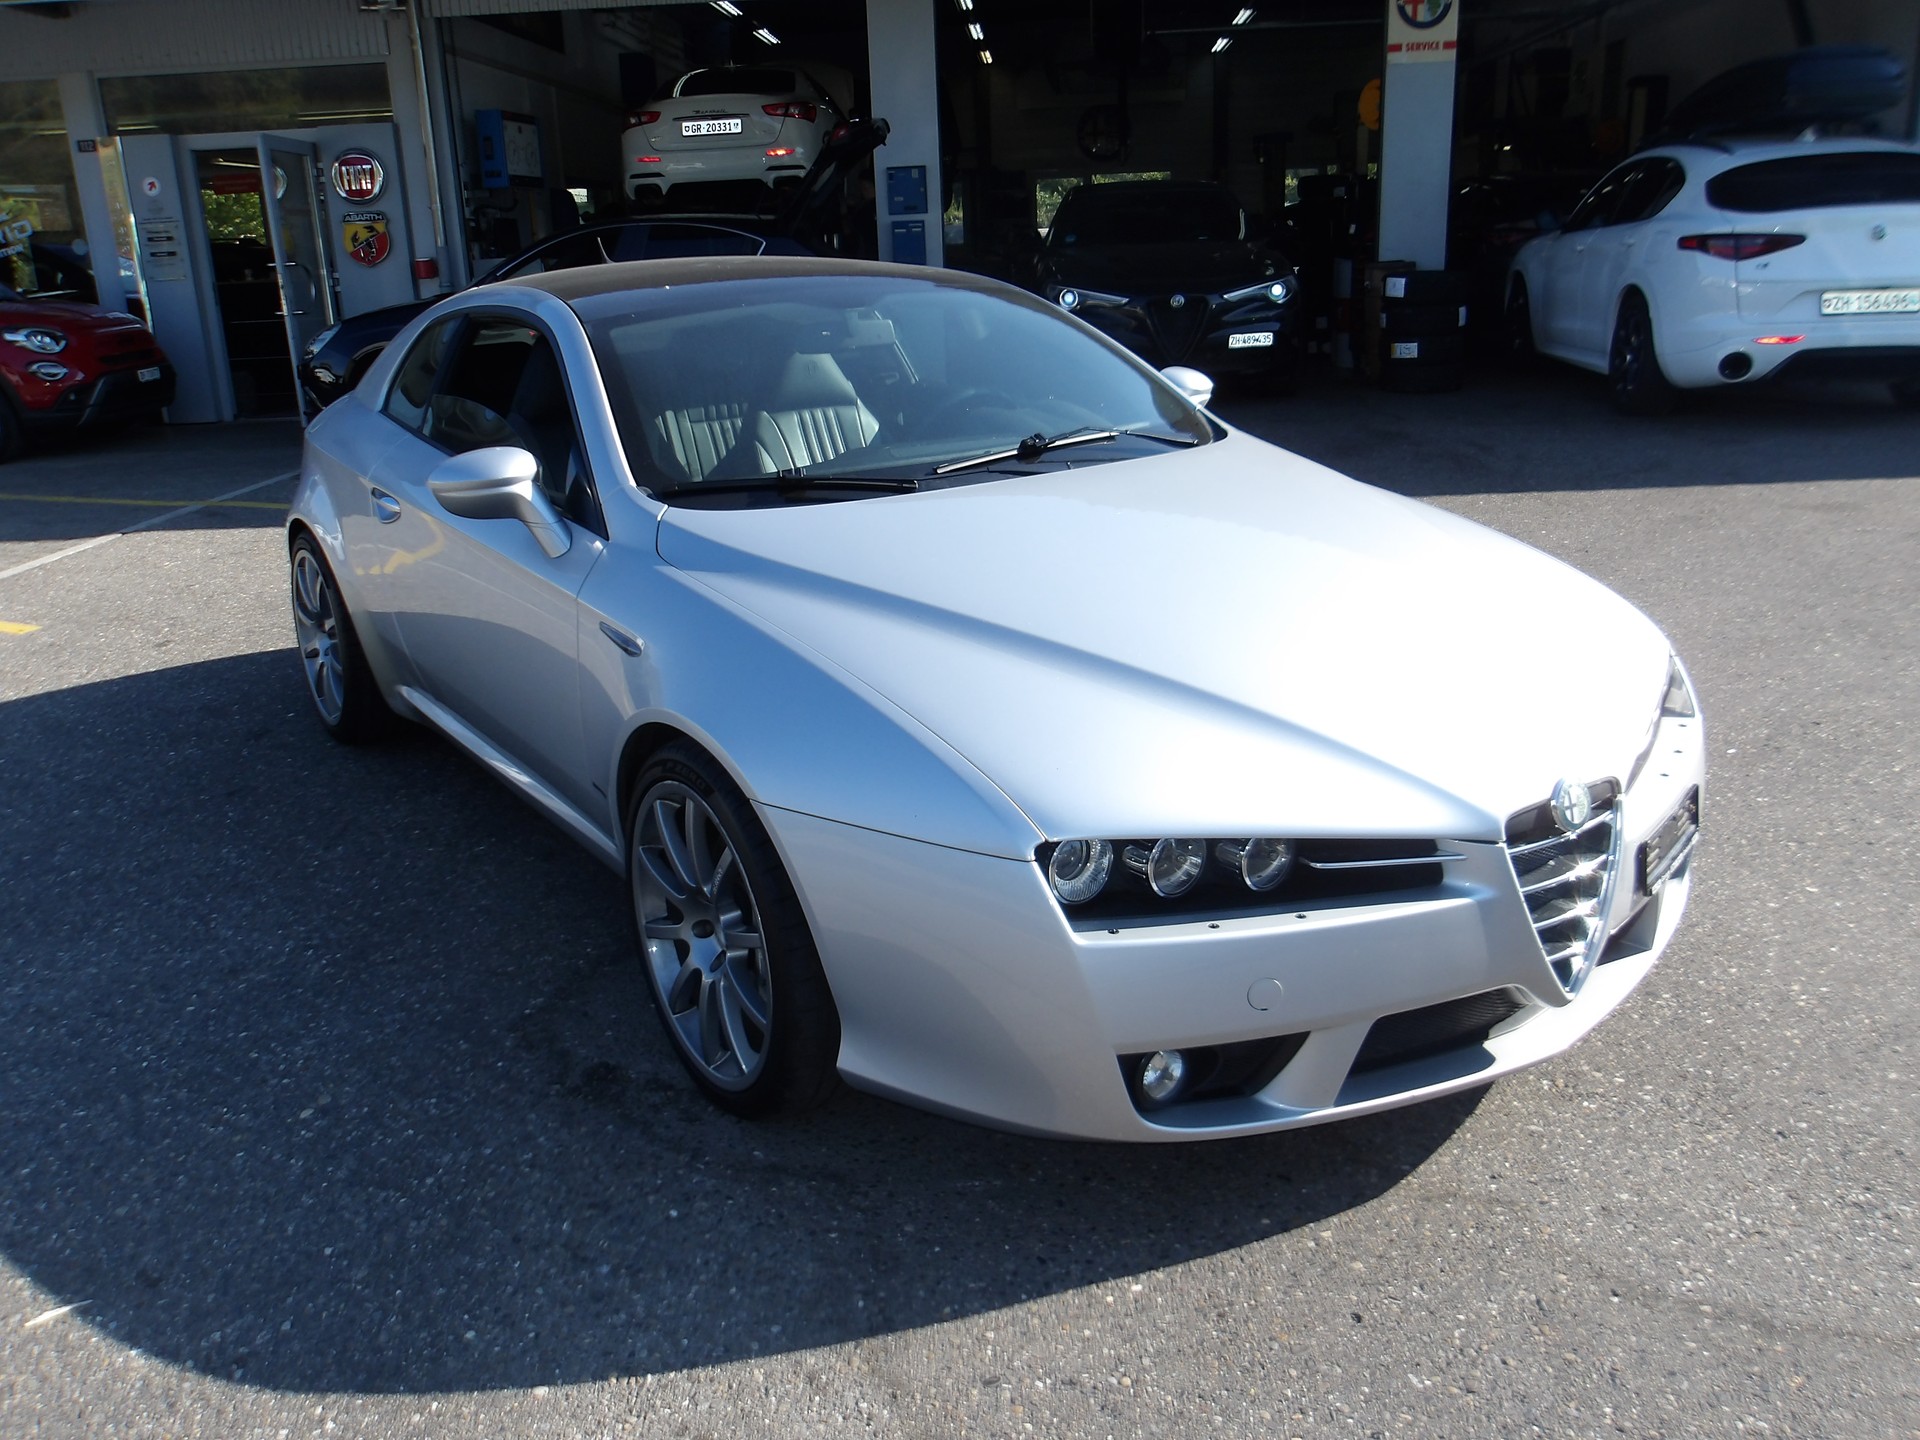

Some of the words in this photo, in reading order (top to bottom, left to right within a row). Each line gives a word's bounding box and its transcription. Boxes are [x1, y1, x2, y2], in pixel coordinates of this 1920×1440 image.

[1405, 41, 1440, 52] SERVICE
[341, 164, 373, 191] FIAT
[344, 213, 383, 222] ABARTH
